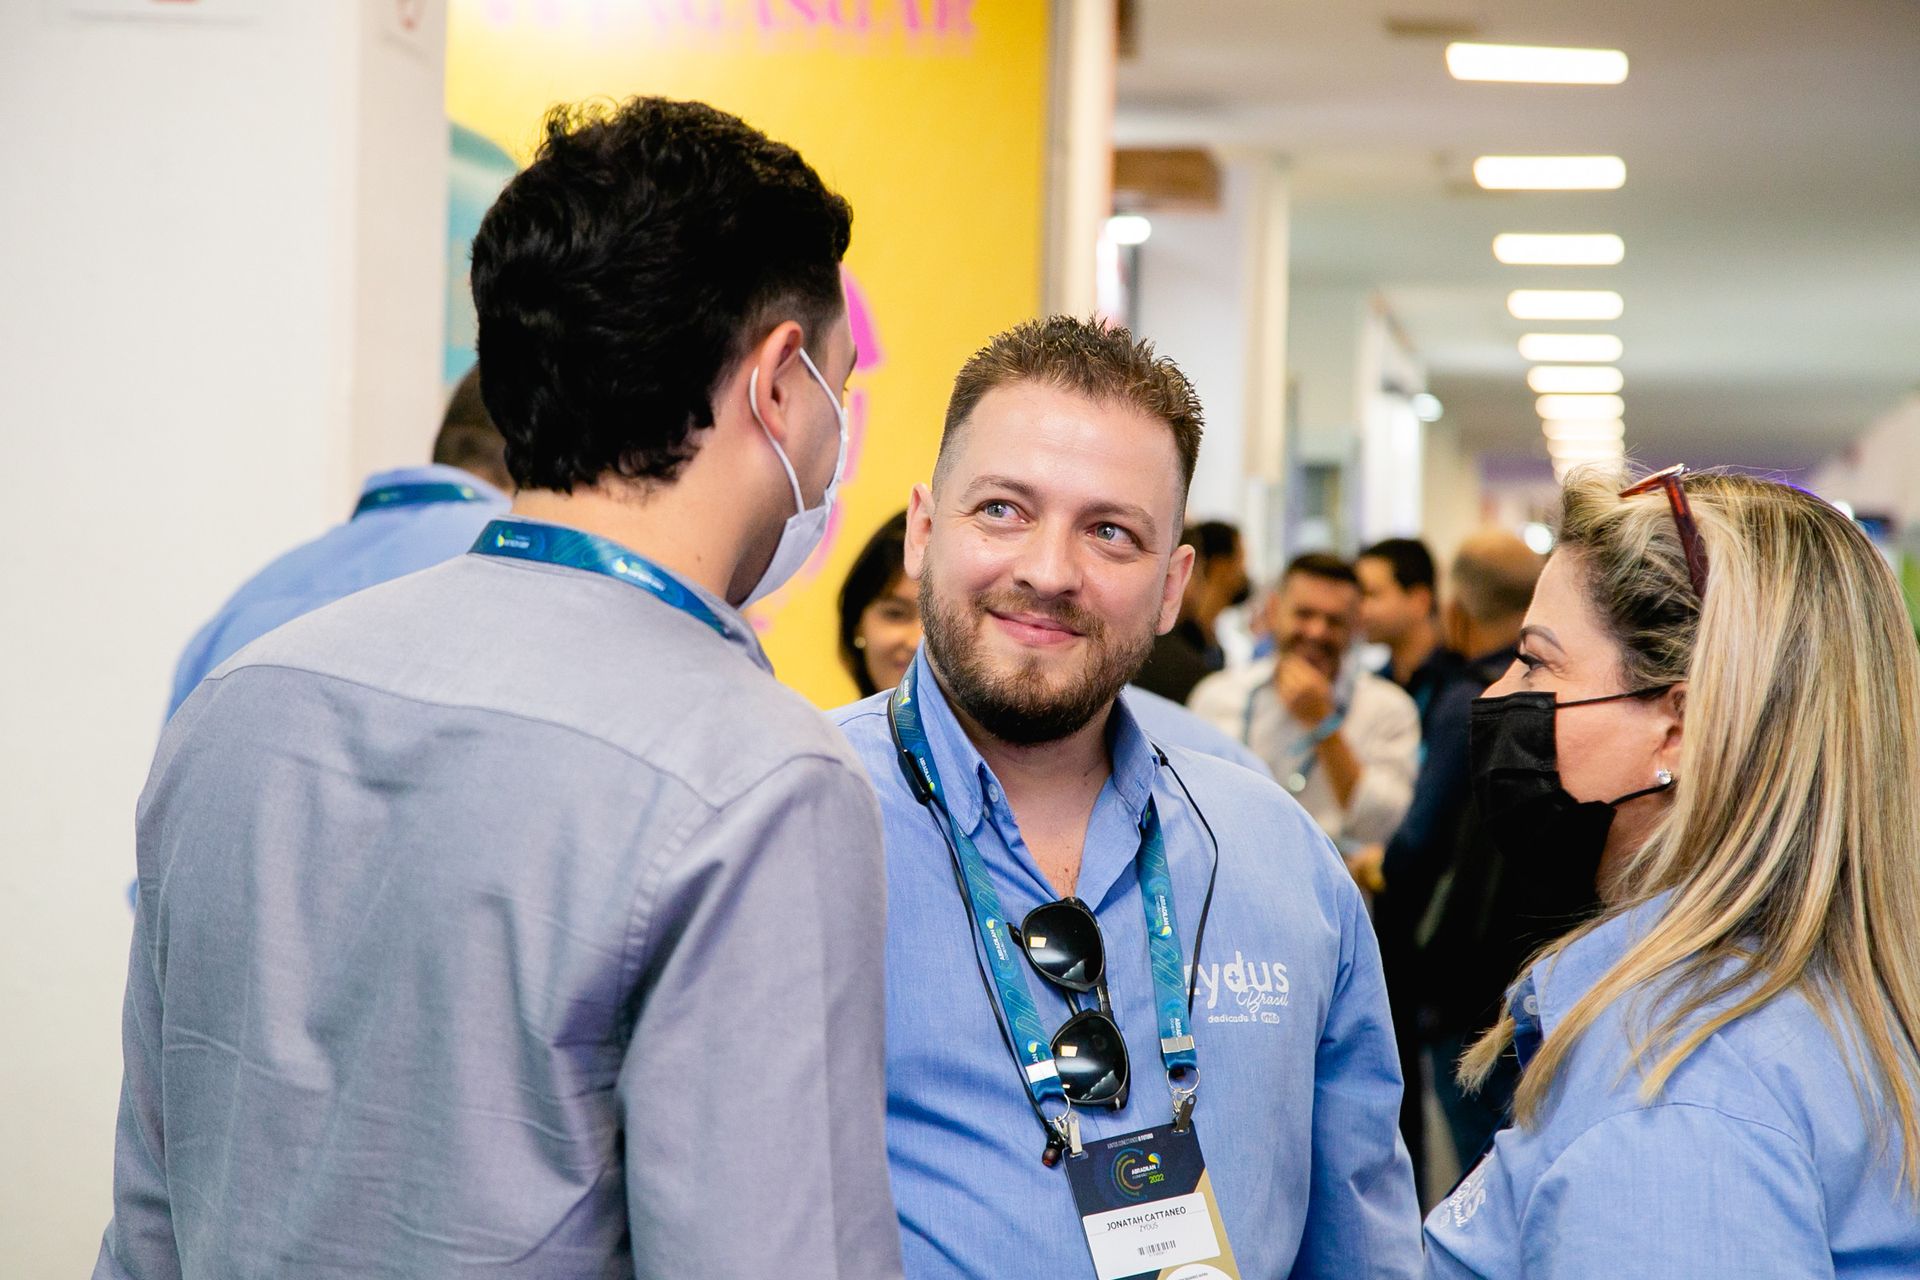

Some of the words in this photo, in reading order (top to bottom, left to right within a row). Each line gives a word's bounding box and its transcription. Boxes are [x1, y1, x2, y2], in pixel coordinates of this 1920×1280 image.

[1149, 1173, 1165, 1184] 2022
[1106, 1216, 1143, 1231] JONATAH
[1144, 1206, 1186, 1222] CATTANEO
